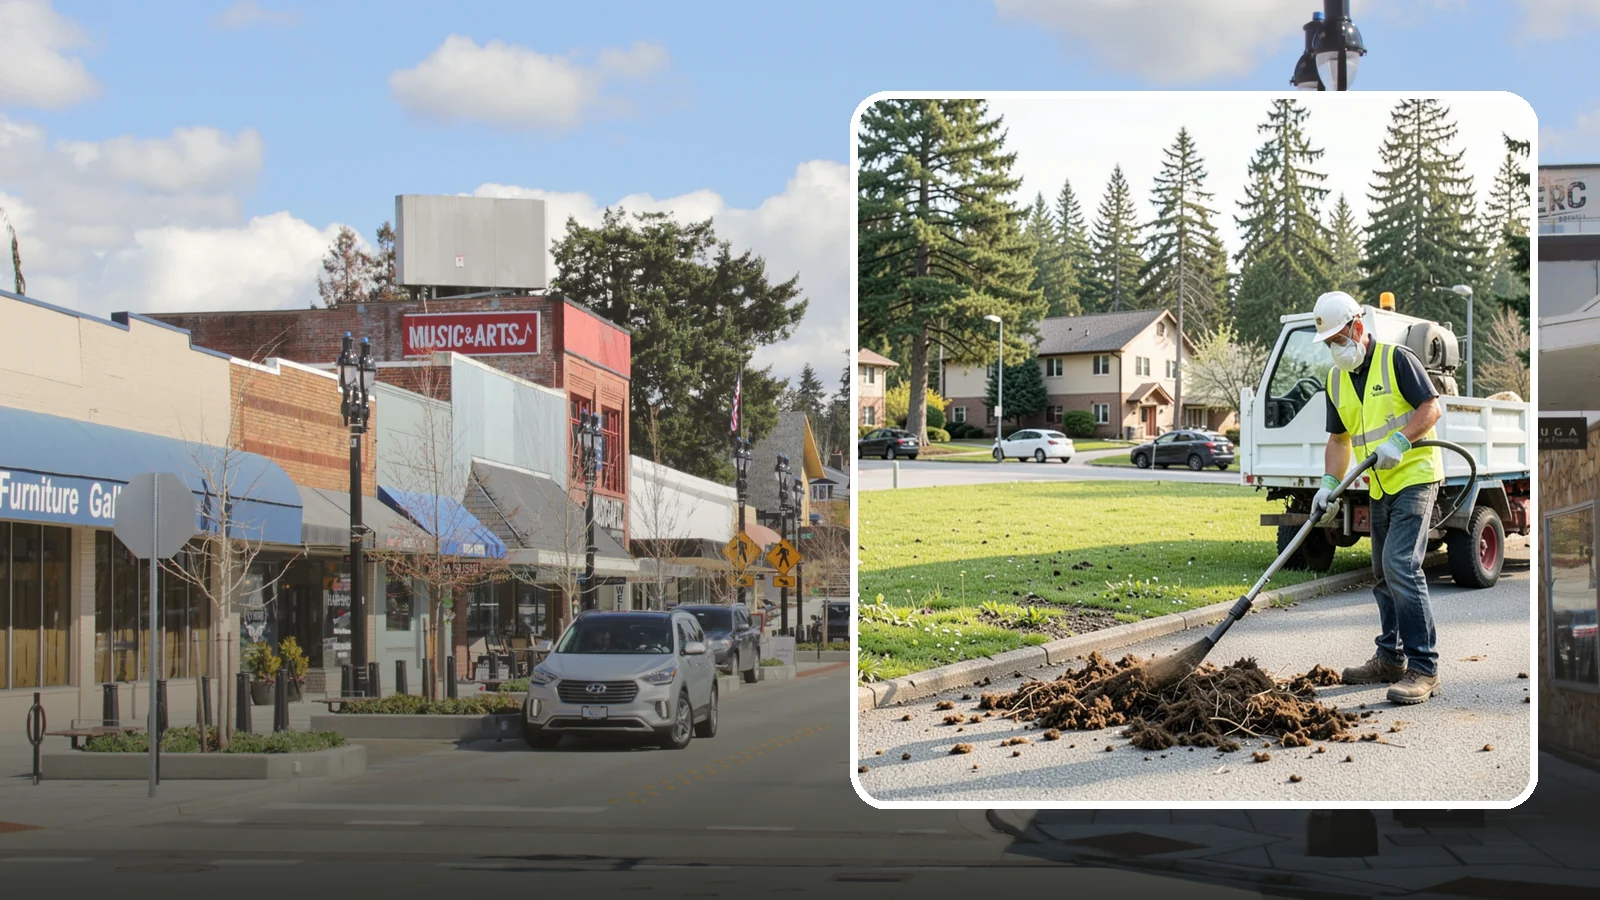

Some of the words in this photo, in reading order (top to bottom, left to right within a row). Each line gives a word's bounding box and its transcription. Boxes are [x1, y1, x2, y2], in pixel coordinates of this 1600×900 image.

[0, 471, 80, 516] Furniture
[89, 482, 122, 520] Gal
[453, 563, 479, 575] SUSHI
